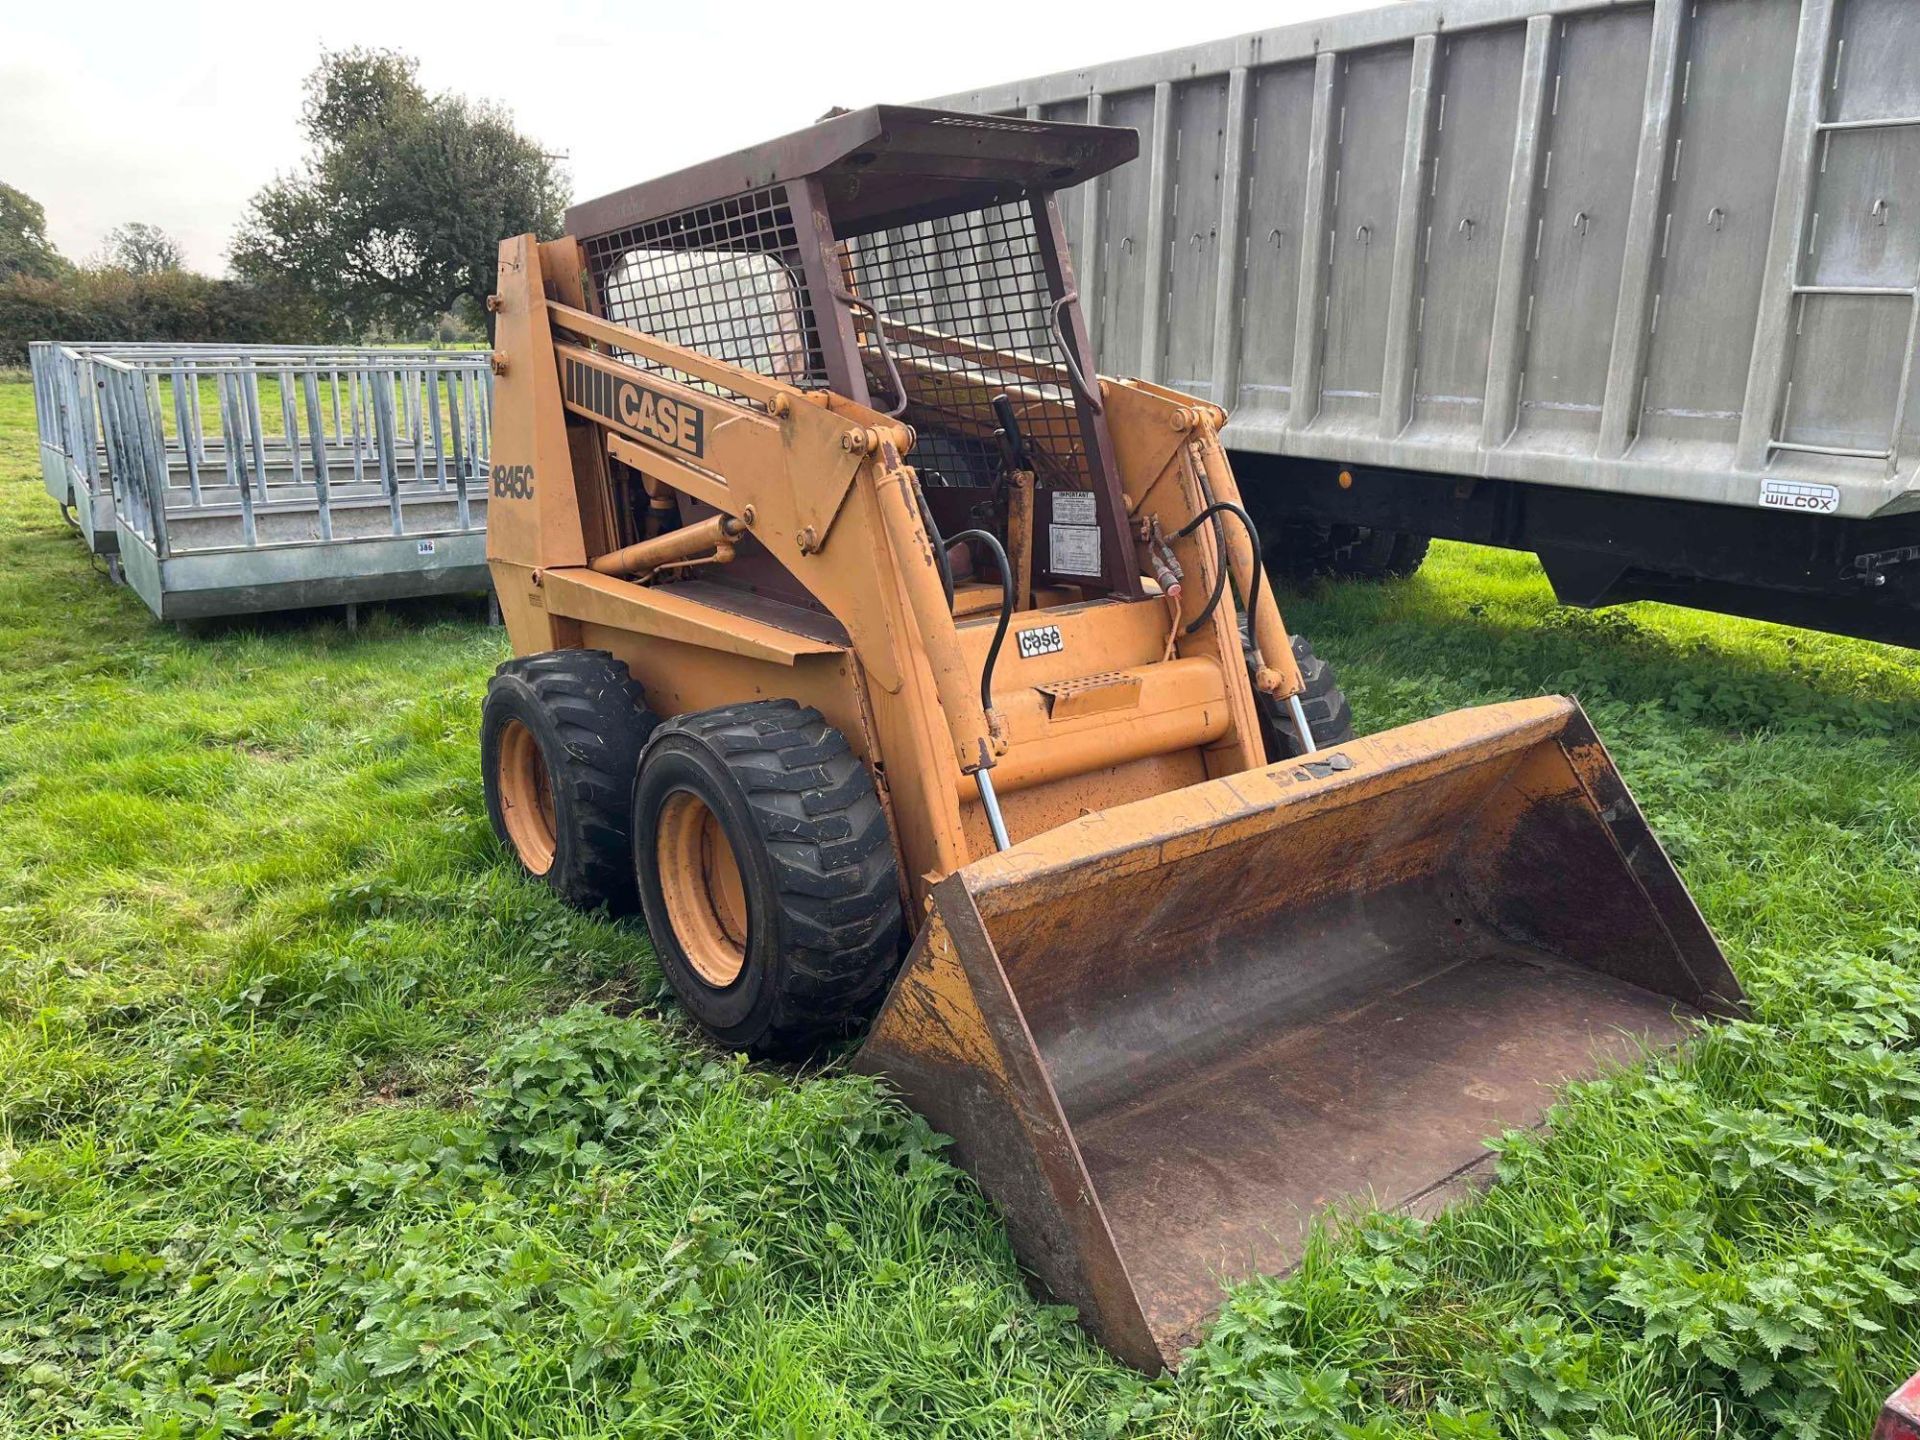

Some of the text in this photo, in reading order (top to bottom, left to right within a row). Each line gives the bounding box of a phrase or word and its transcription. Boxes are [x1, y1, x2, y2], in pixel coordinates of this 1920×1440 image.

[619, 382, 697, 454] CASE
[492, 464, 535, 501] 1845C
[1765, 493, 1832, 511] WILCOX
[1021, 630, 1062, 655] case
